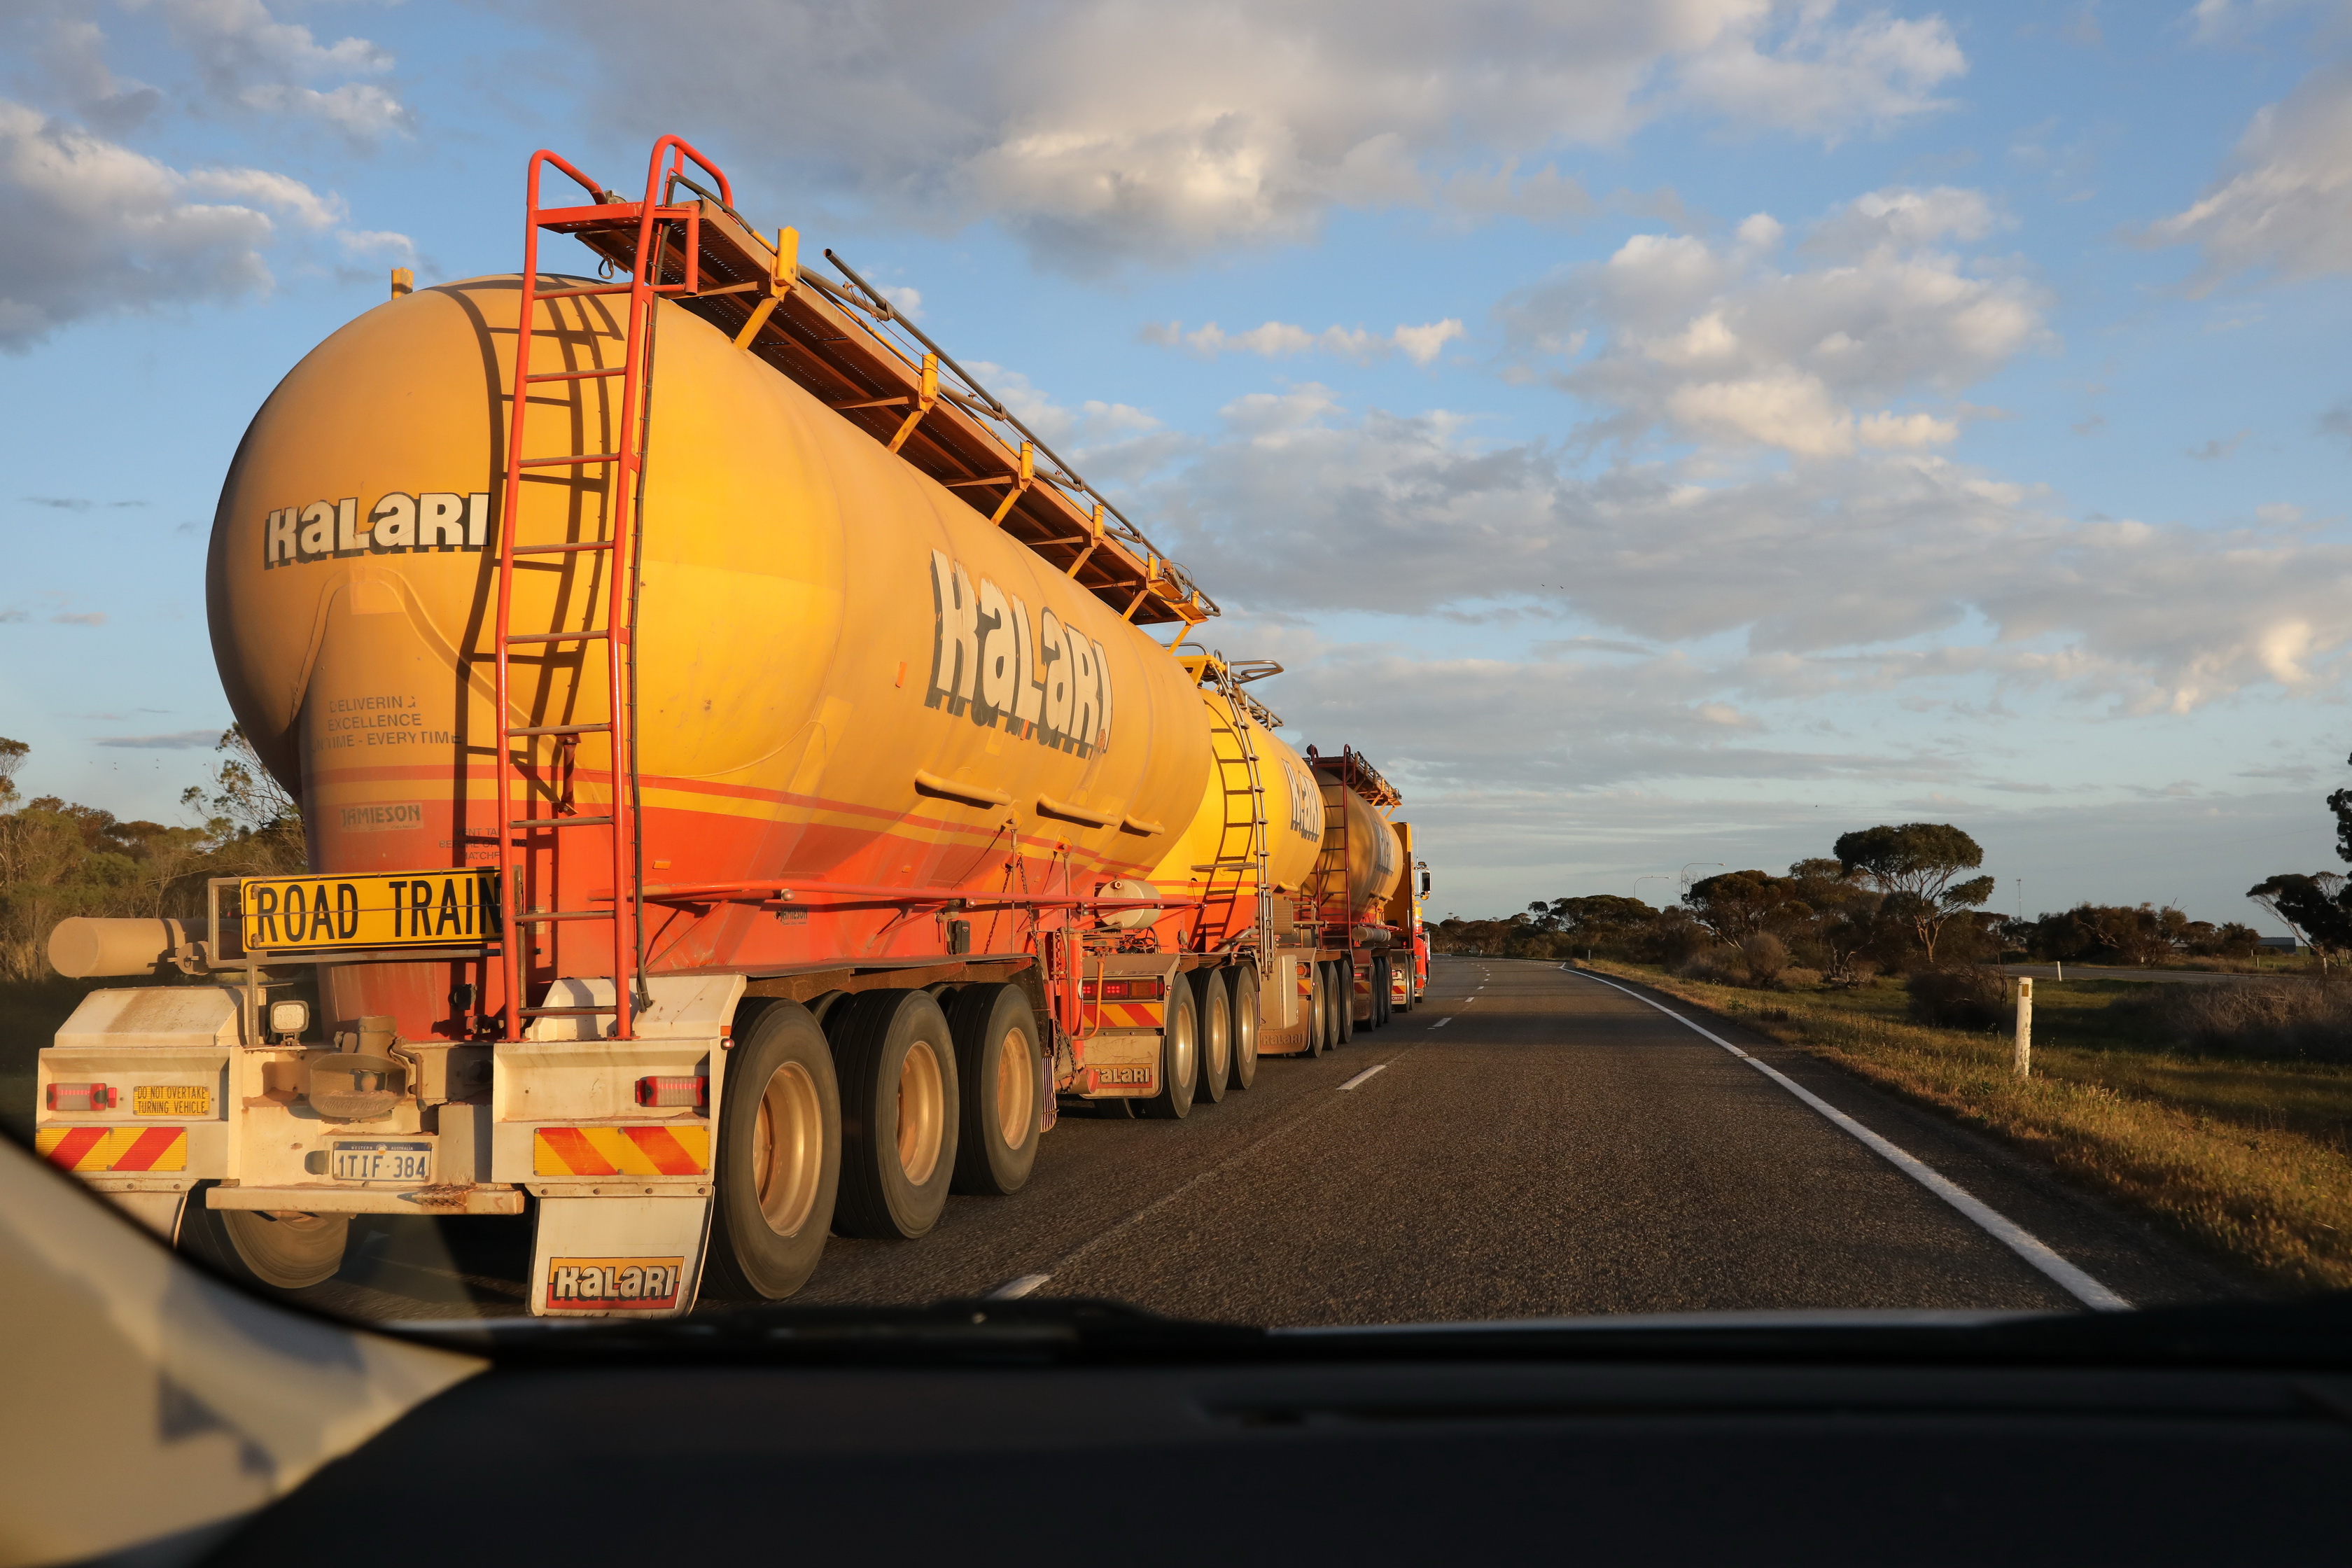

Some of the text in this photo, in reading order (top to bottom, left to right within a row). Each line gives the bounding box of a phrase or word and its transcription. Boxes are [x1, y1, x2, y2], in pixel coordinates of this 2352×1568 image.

[328, 713, 422, 732] EXCELLENCE
[367, 732, 416, 746] EVERY
[340, 804, 421, 827] JAMIESON
[456, 828, 500, 836] VENT TA
[439, 839, 527, 848] BEFORE OPNG
[258, 883, 358, 942] ROAD
[388, 877, 503, 938] TRAIN
[137, 1086, 206, 1099] DO NOT OVERTAKE
[138, 1101, 206, 1114] TURNING VEHICLE
